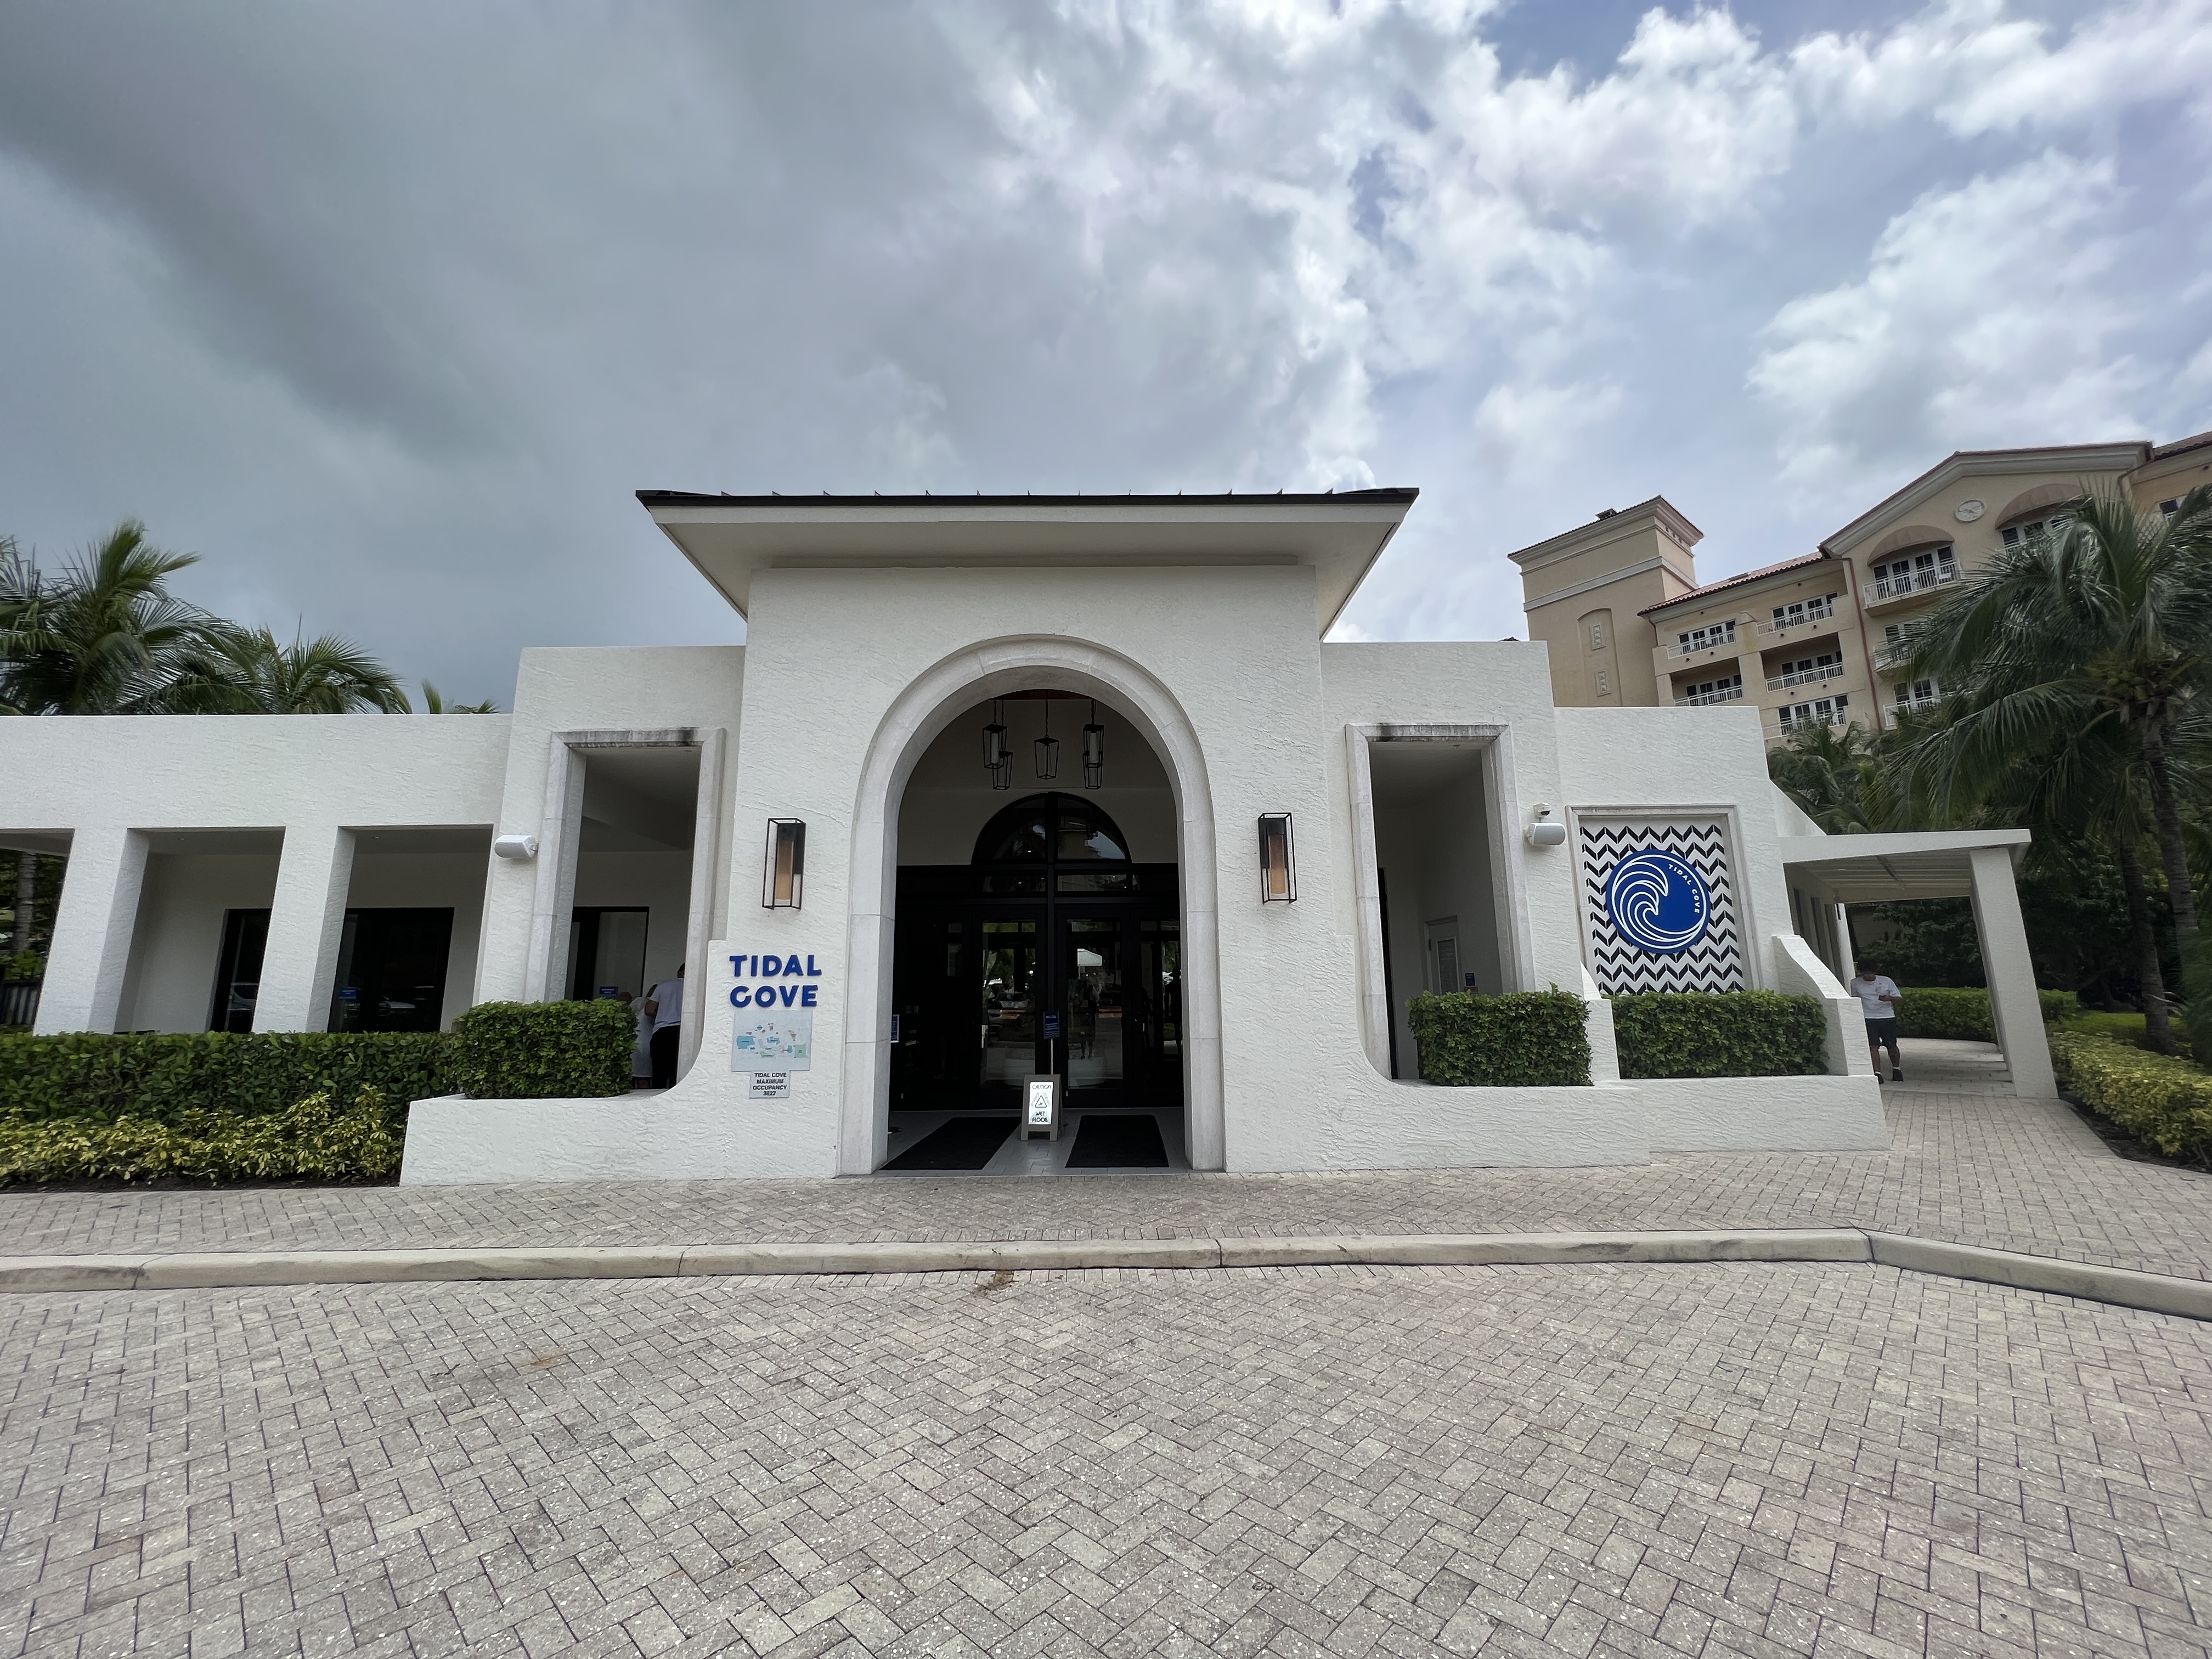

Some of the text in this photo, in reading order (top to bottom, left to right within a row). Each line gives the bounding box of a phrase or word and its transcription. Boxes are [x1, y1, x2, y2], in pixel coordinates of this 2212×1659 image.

[1669, 864, 1700, 913] TIDAL COVE
[729, 955, 822, 977] TIDAL
[730, 985, 819, 1008] COVE
